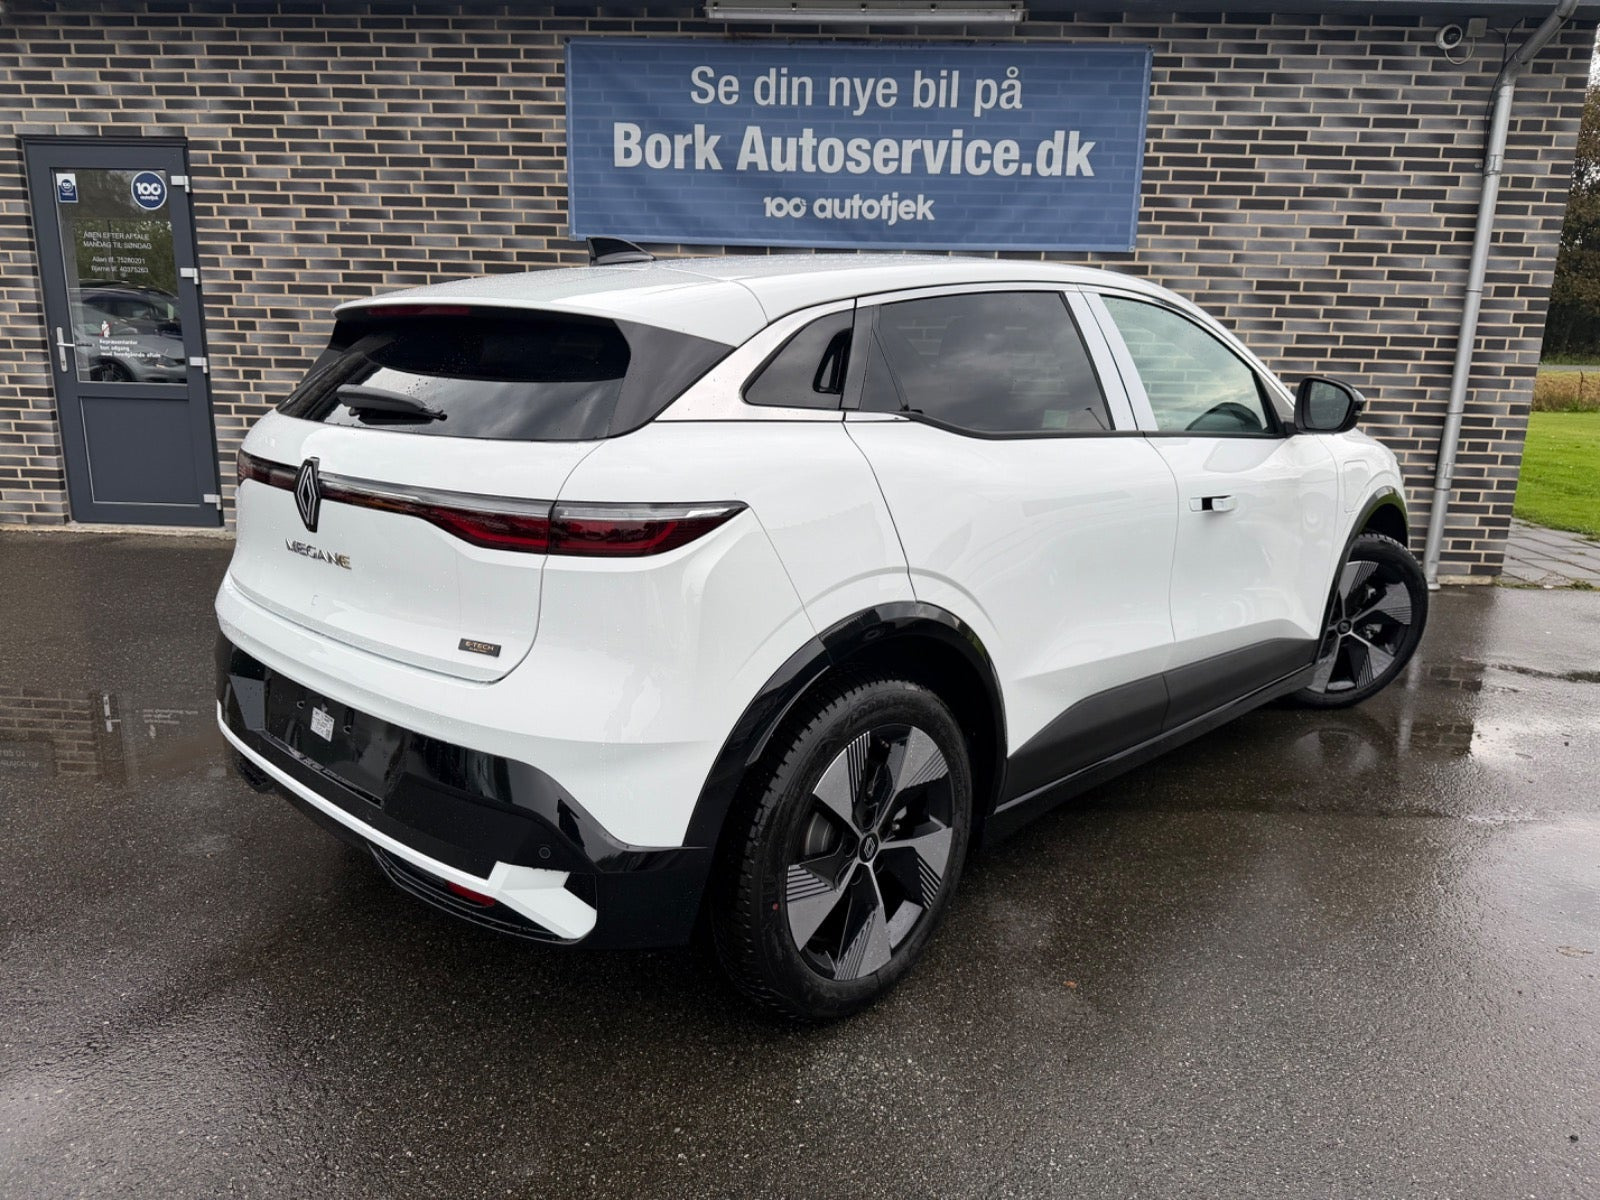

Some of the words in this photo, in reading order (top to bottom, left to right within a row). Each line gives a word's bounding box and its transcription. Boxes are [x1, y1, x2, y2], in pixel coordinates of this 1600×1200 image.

[691, 65, 740, 106] Se
[753, 67, 814, 107] din
[828, 76, 898, 117] nye
[912, 70, 960, 108] bil
[973, 66, 1023, 117] på
[613, 122, 723, 170] Bork
[736, 125, 1096, 177] Autoservice.dk
[135, 182, 162, 196] 100
[763, 196, 807, 219] 100
[812, 191, 935, 226] autotjek
[83, 241, 112, 249] MANDAG
[112, 241, 122, 249] TIL
[123, 242, 153, 250] SØNDAG
[102, 231, 124, 240] EFTER
[285, 537, 352, 570] MEGANE
